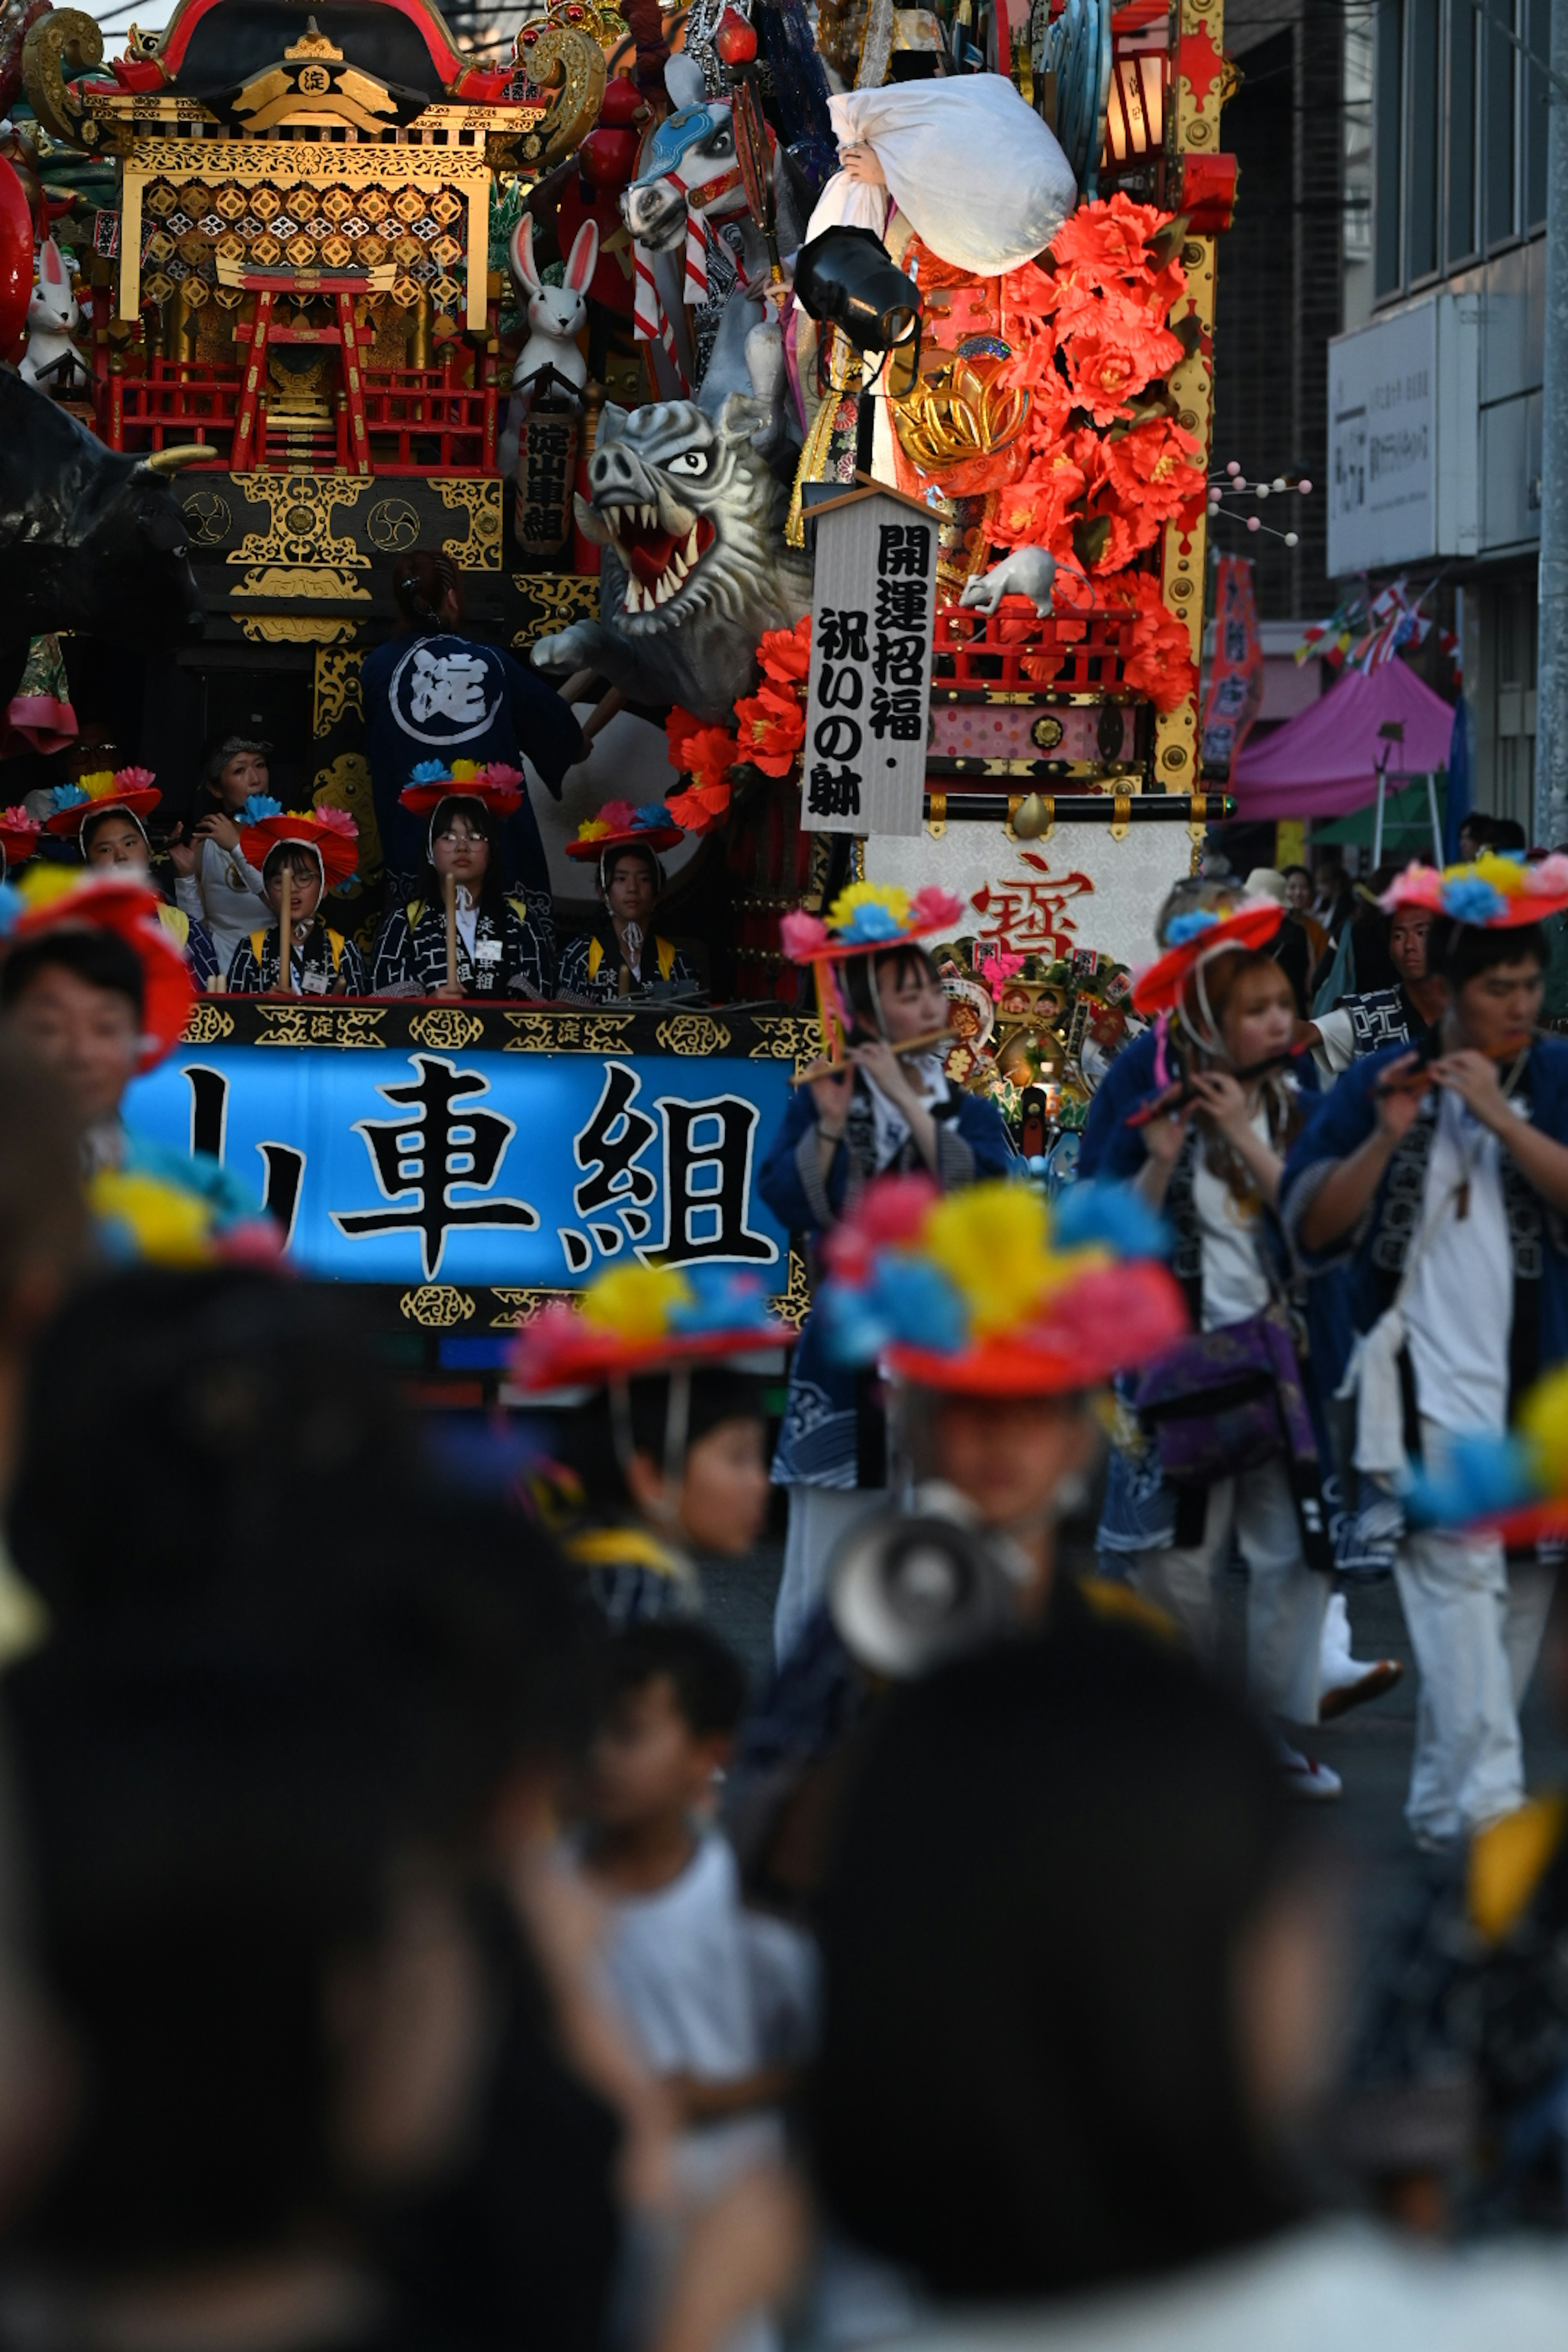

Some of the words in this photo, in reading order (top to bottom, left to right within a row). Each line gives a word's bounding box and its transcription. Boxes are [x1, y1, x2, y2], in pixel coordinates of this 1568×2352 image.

[305, 71, 324, 91] 淀
[523, 423, 570, 542] 淀山車組
[310, 1015, 334, 1038] 淀
[557, 1020, 580, 1043] 淀
